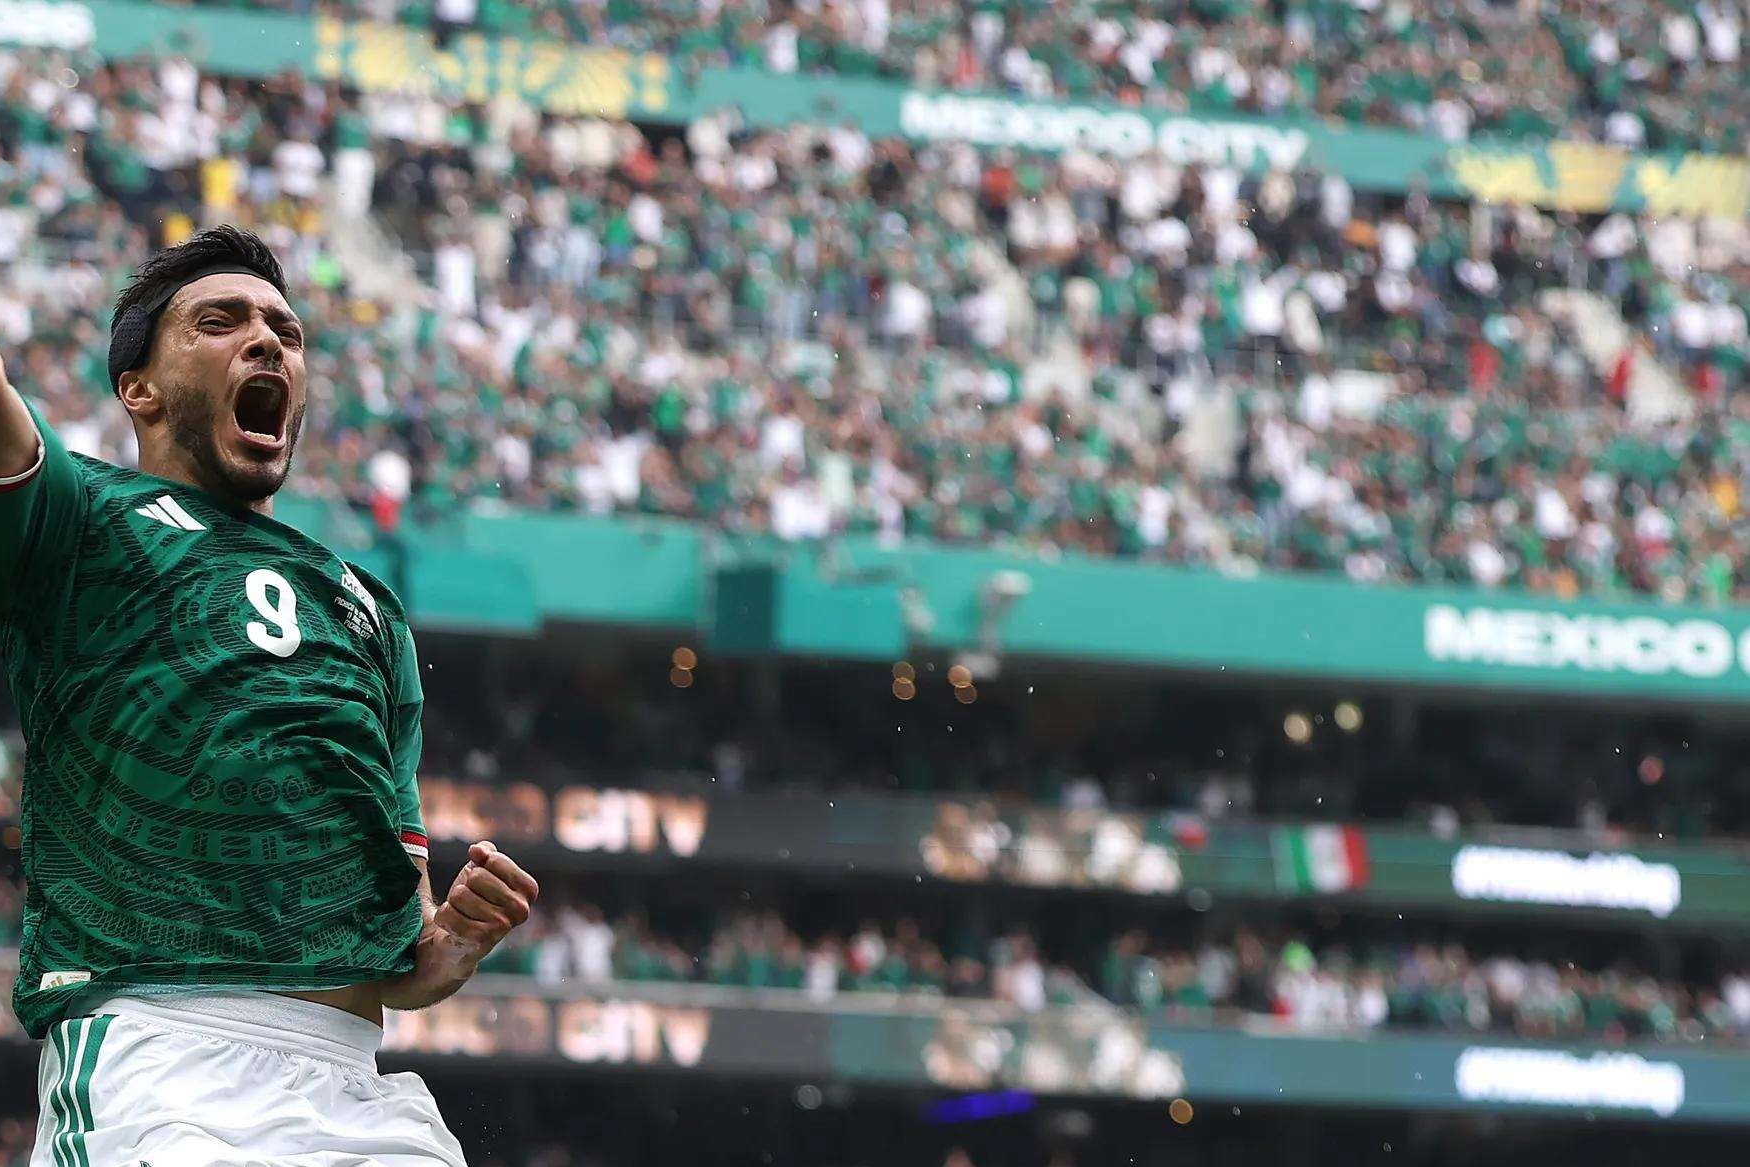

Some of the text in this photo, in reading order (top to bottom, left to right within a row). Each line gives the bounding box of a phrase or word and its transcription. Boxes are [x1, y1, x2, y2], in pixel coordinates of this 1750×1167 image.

[900, 92, 1309, 170] MEXICO CITY
[245, 568, 302, 657] 9
[1424, 604, 1734, 678] MEXICO
